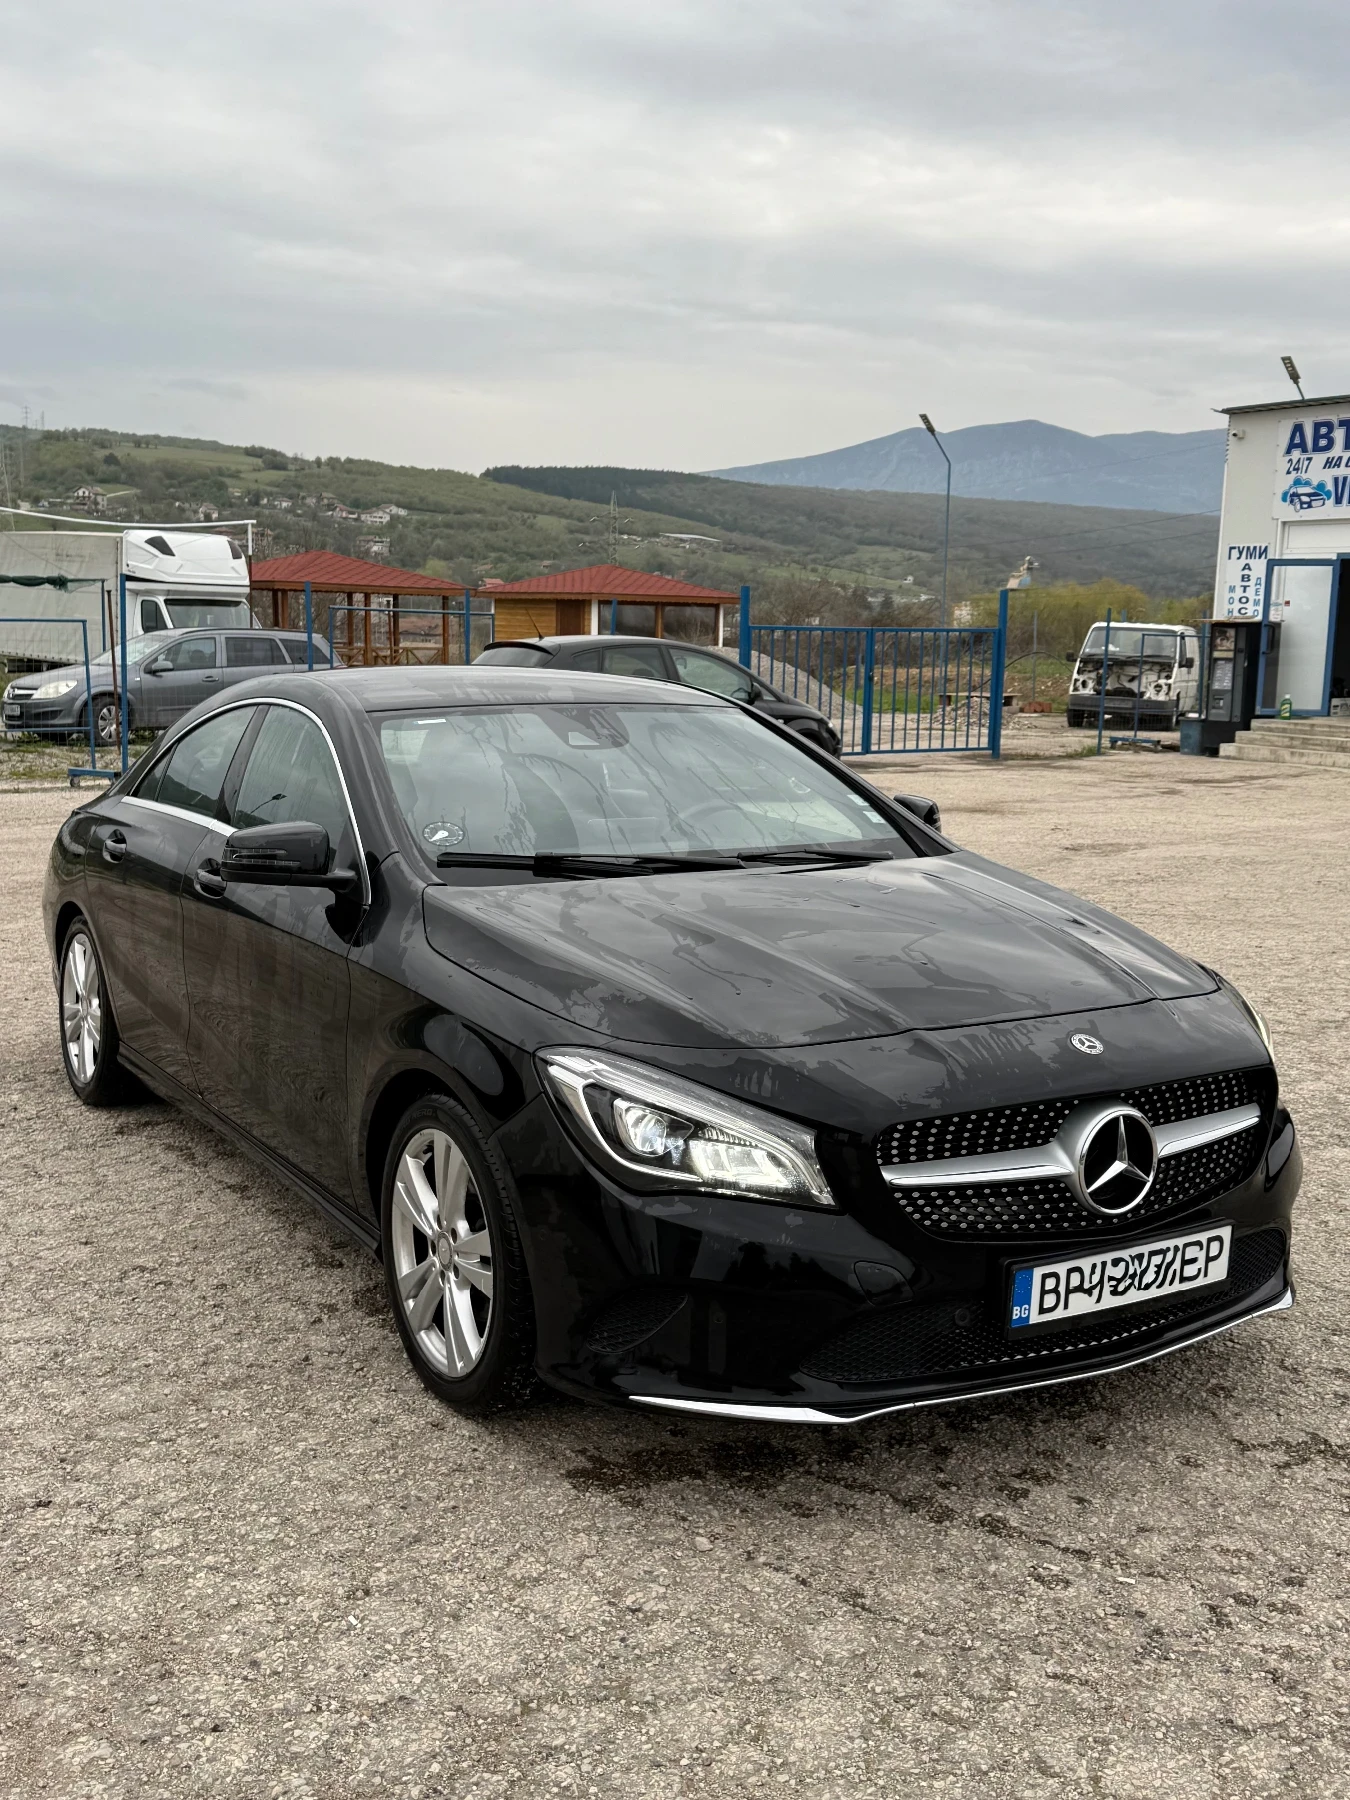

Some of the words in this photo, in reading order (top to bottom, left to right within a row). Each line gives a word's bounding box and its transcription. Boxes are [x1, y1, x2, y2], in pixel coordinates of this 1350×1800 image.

[1323, 455, 1343, 469] НА
[1228, 545, 1268, 560] ГУМИ
[1012, 1305, 1029, 1320] BG
